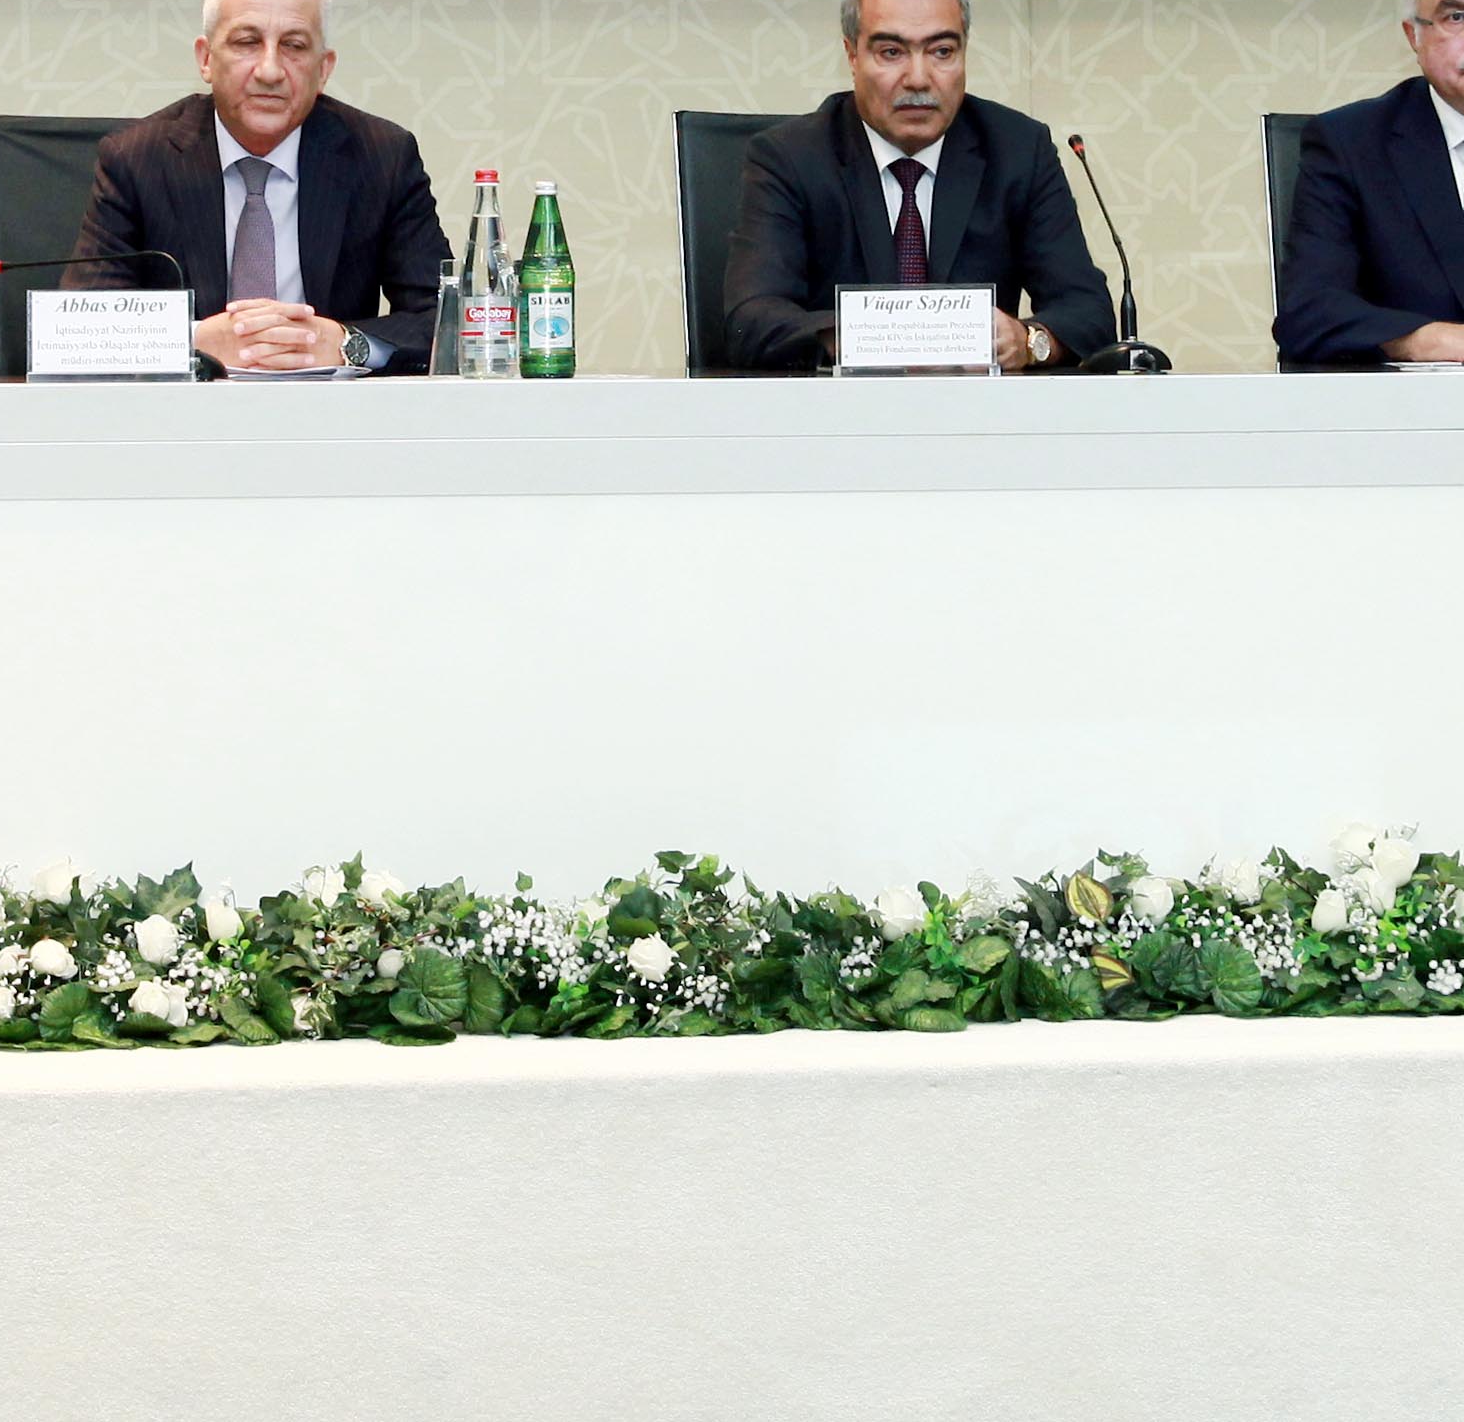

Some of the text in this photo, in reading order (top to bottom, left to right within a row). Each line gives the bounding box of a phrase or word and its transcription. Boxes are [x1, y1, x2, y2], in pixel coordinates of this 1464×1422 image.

[55, 296, 168, 316] Abbas Əliyev
[862, 294, 972, 314] Vüqar Səfərli
